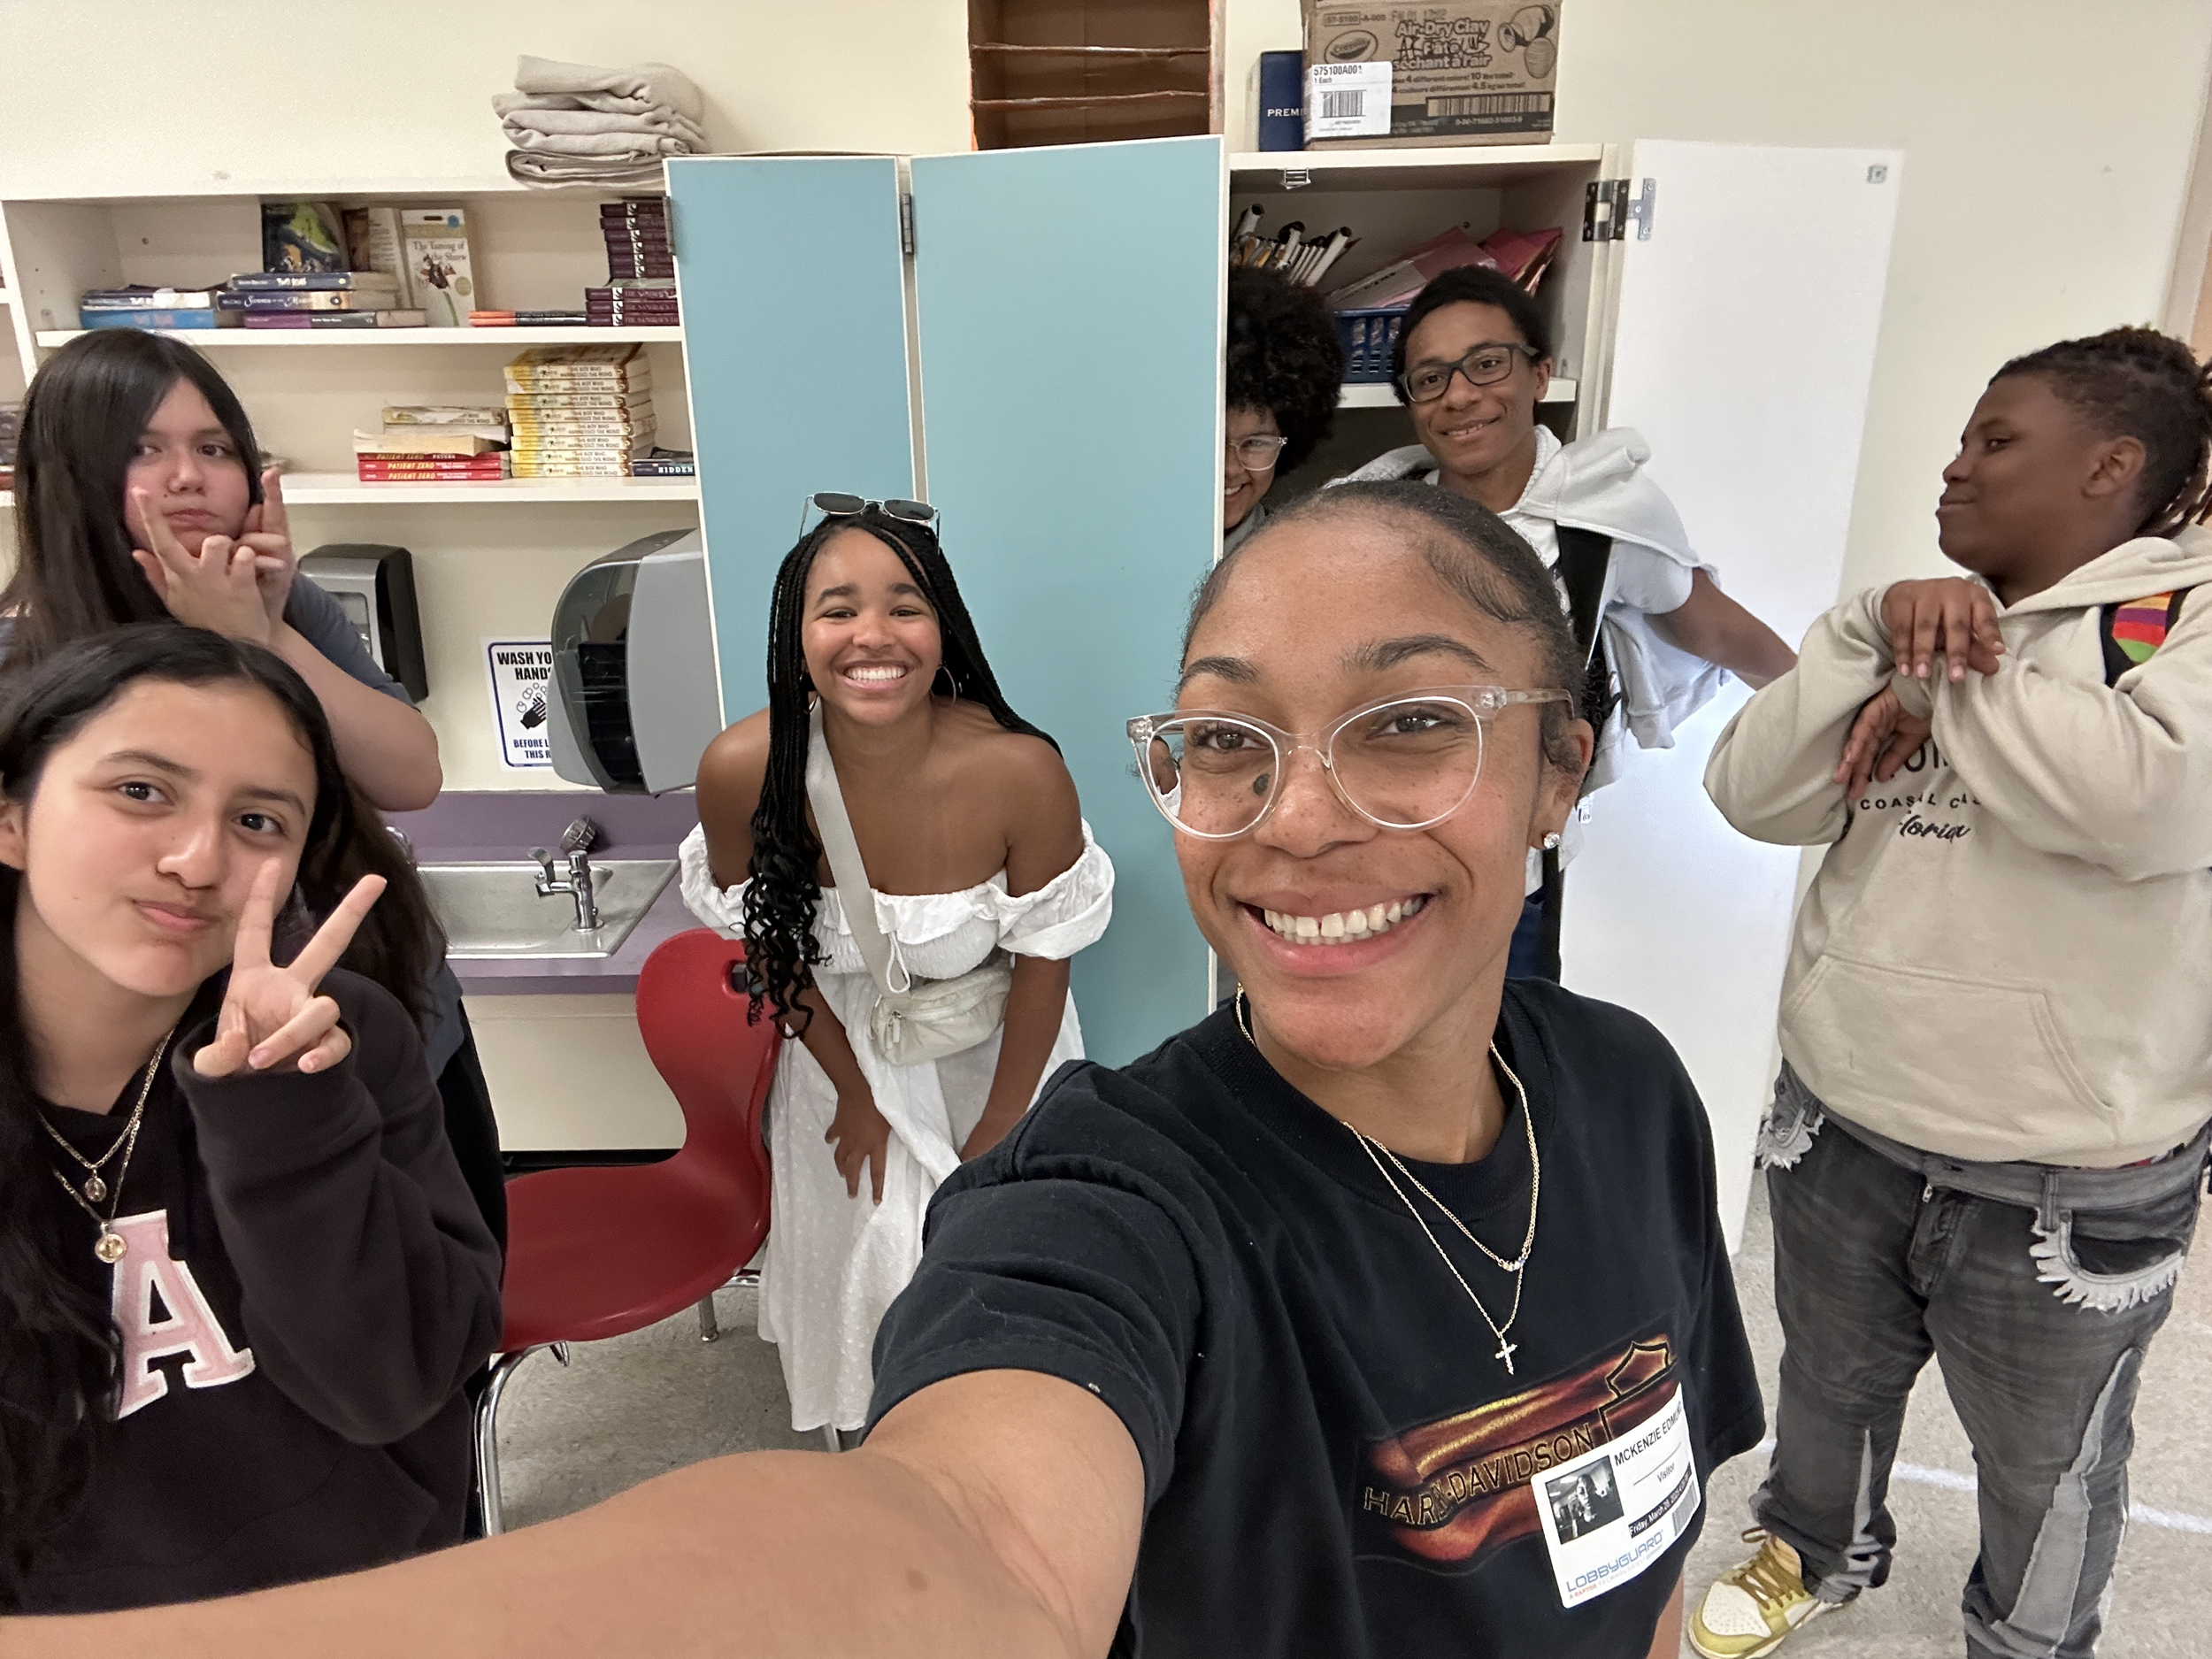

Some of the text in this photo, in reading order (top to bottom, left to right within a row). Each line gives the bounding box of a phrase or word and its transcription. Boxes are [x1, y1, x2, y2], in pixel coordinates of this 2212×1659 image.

[1455, 18, 1490, 35] Clay
[414, 241, 427, 250] The
[457, 241, 465, 250] of
[497, 652, 552, 664] WASH YO
[513, 739, 541, 749] BEFORE
[525, 750, 543, 759] THIS
[111, 1209, 256, 1420] A
[1614, 1426, 1662, 1466] MCKENZIE
[1657, 1462, 1675, 1482] Visitor
[1648, 1506, 1663, 1523] March
[1566, 1532, 1663, 1592] LOBBYGUARD
